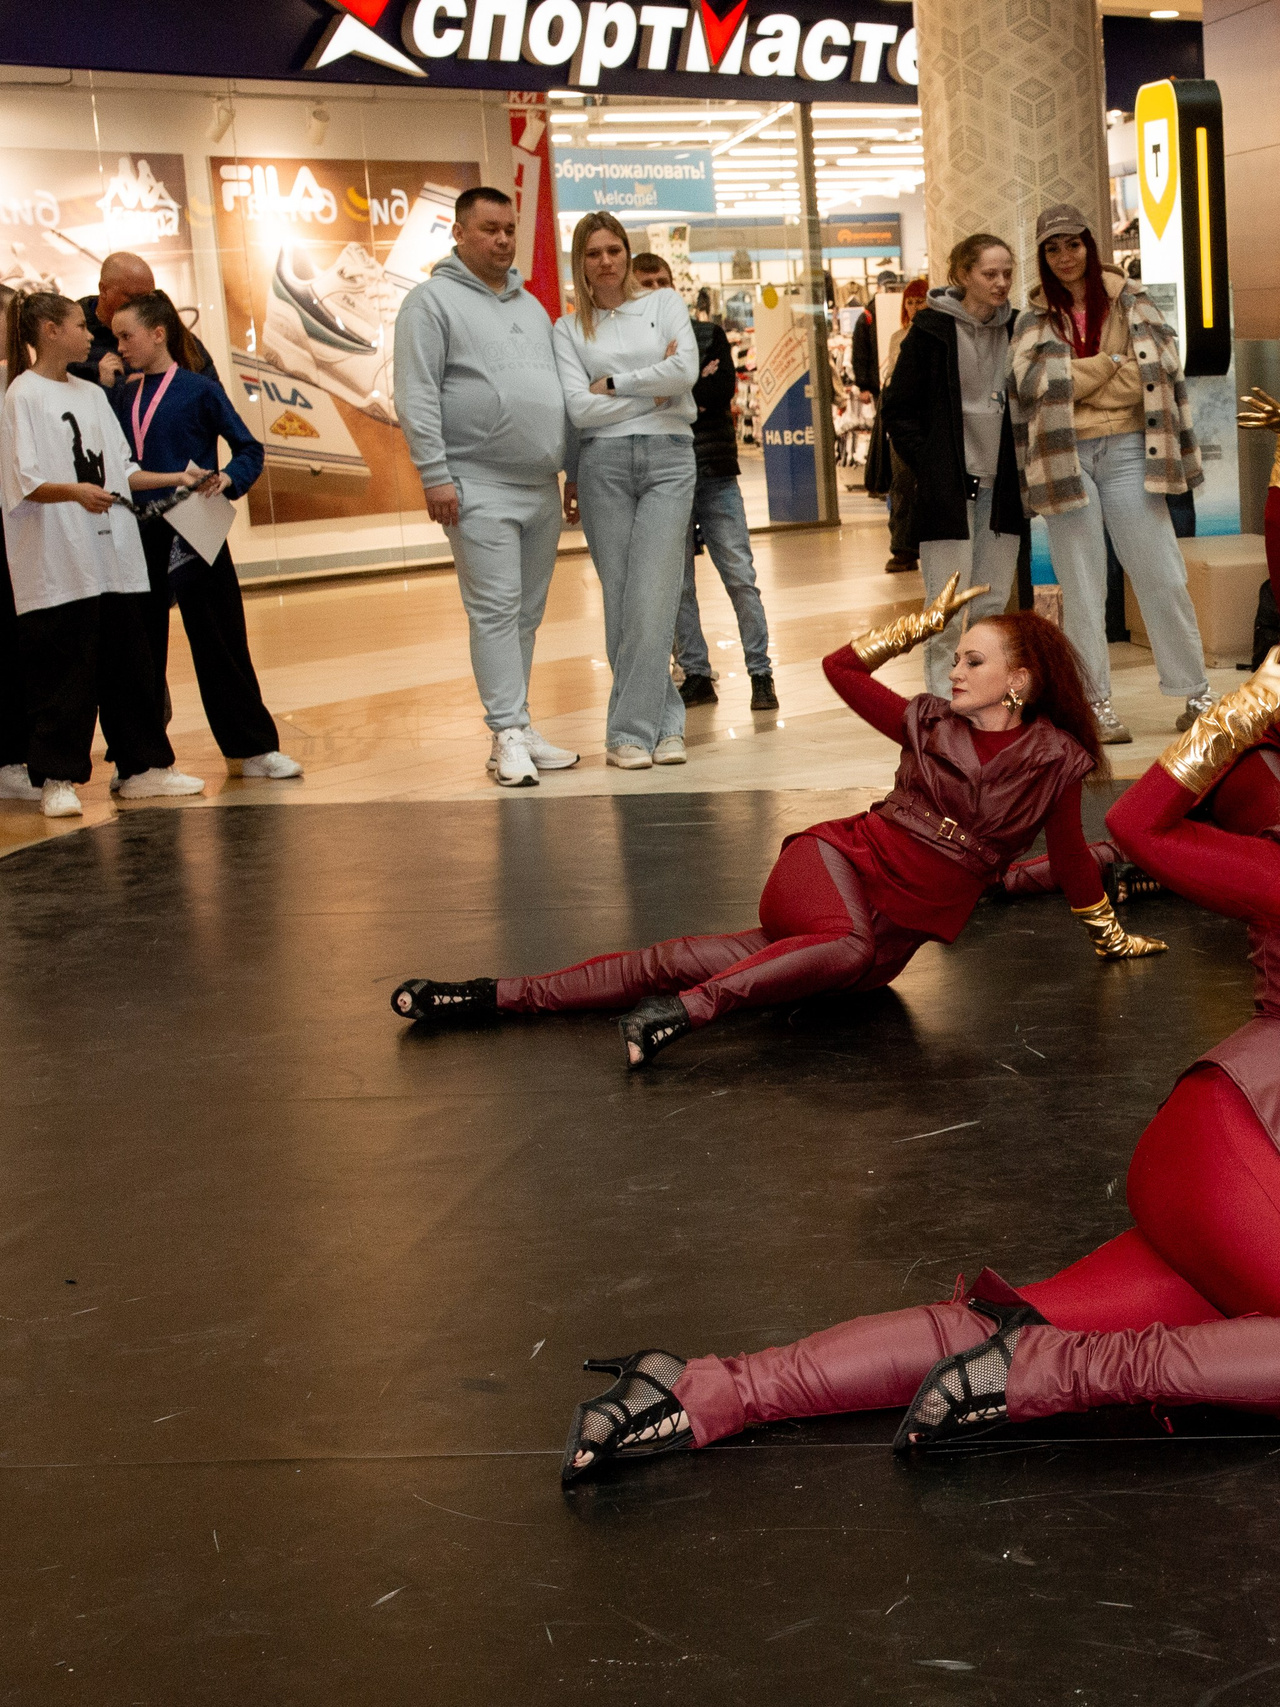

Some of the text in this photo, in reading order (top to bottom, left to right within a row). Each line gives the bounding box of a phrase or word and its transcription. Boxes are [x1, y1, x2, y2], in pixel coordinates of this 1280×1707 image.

[412, 0, 920, 87] спортмаст
[554, 159, 707, 182] обро пожаловать!
[219, 164, 327, 213] FILA
[593, 189, 658, 206] Welcome!
[239, 373, 314, 411] FILA
[764, 425, 816, 446] НА ВСЁ
